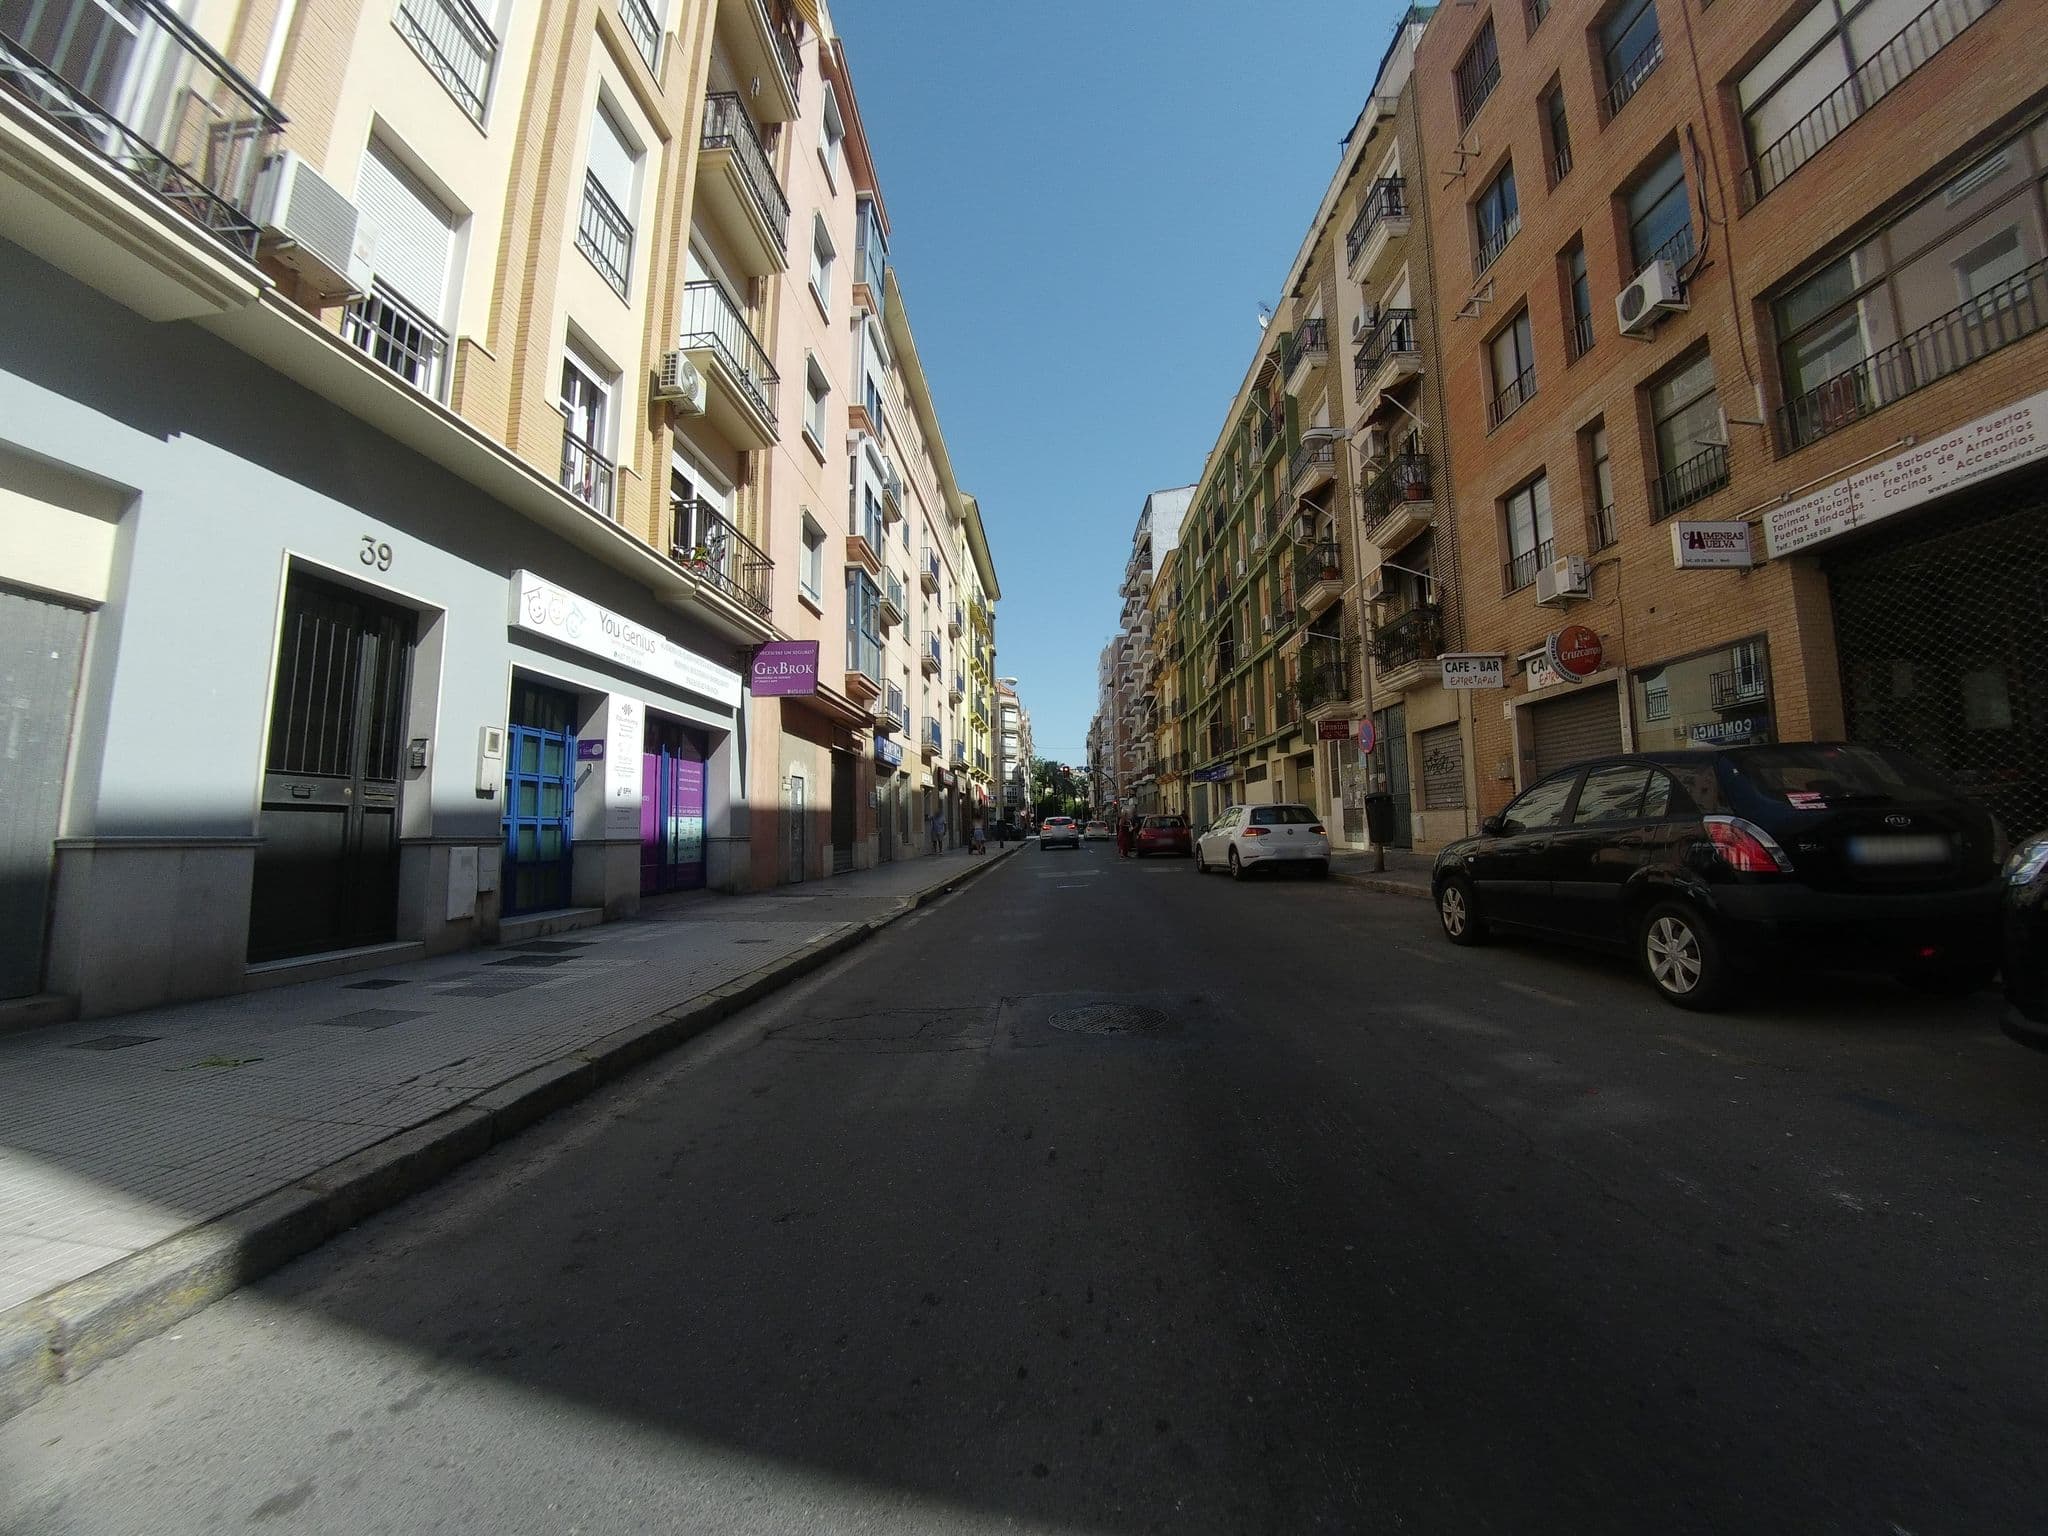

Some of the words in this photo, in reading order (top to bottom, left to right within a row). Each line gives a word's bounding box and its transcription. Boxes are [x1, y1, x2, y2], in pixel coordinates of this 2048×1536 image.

[1771, 496, 1825, 524] Chimeneas
[1895, 437, 1964, 471] Barbacoas
[1975, 408, 2032, 437] Puertas
[1772, 512, 1810, 533] Tarimas
[1817, 492, 1861, 515] Flotane
[1882, 463, 1928, 488] Frentes
[1936, 453, 1955, 465] de
[1965, 420, 2033, 454] Armarios
[1774, 524, 1809, 543] Puertas
[1883, 474, 1934, 499] Cocinas
[1955, 433, 2036, 471] Accesorios
[359, 534, 393, 572] 39
[599, 610, 620, 638] You
[622, 624, 656, 654] Genius
[1445, 661, 1470, 673] CAFE
[1479, 660, 1500, 672] BAR
